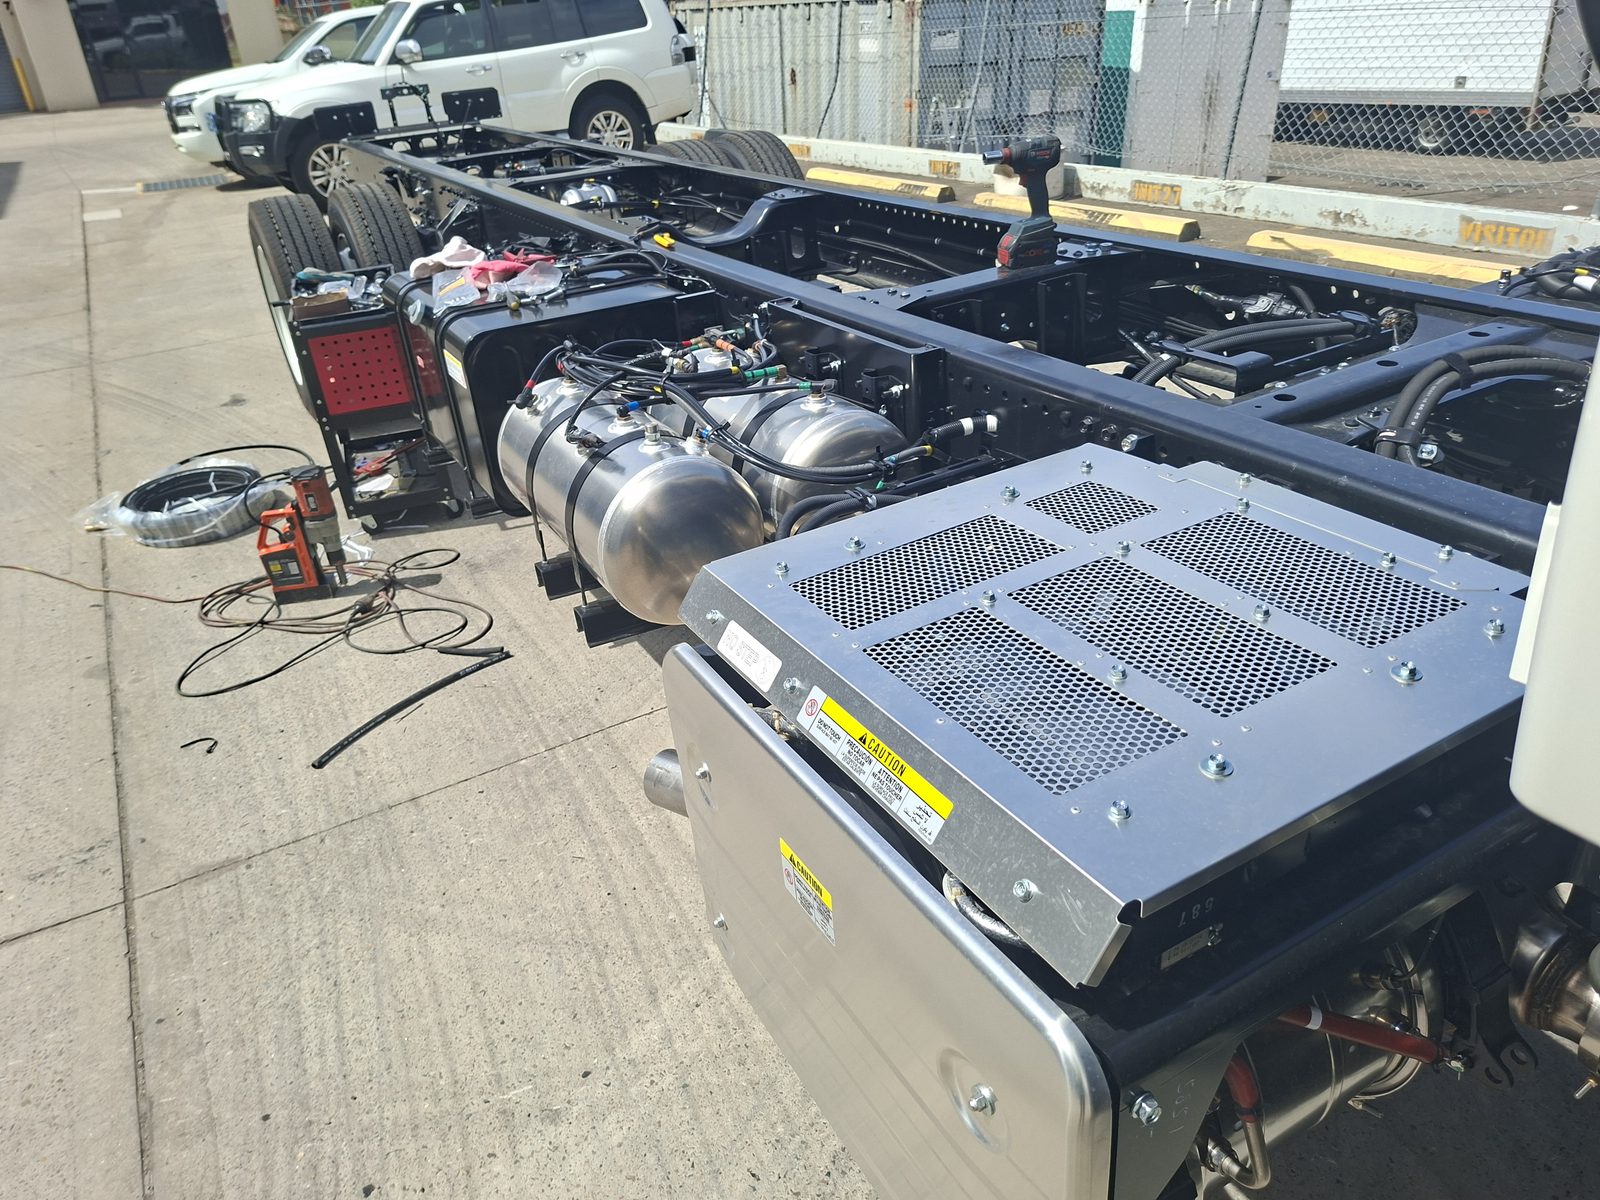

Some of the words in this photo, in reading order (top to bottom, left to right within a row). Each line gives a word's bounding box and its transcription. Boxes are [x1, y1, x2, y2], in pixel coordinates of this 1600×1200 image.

[867, 738, 907, 777] CAUTION
[877, 767, 904, 793] ATTENTION
[884, 783, 903, 801] TOUCHER
[796, 860, 823, 898] CAUTION
